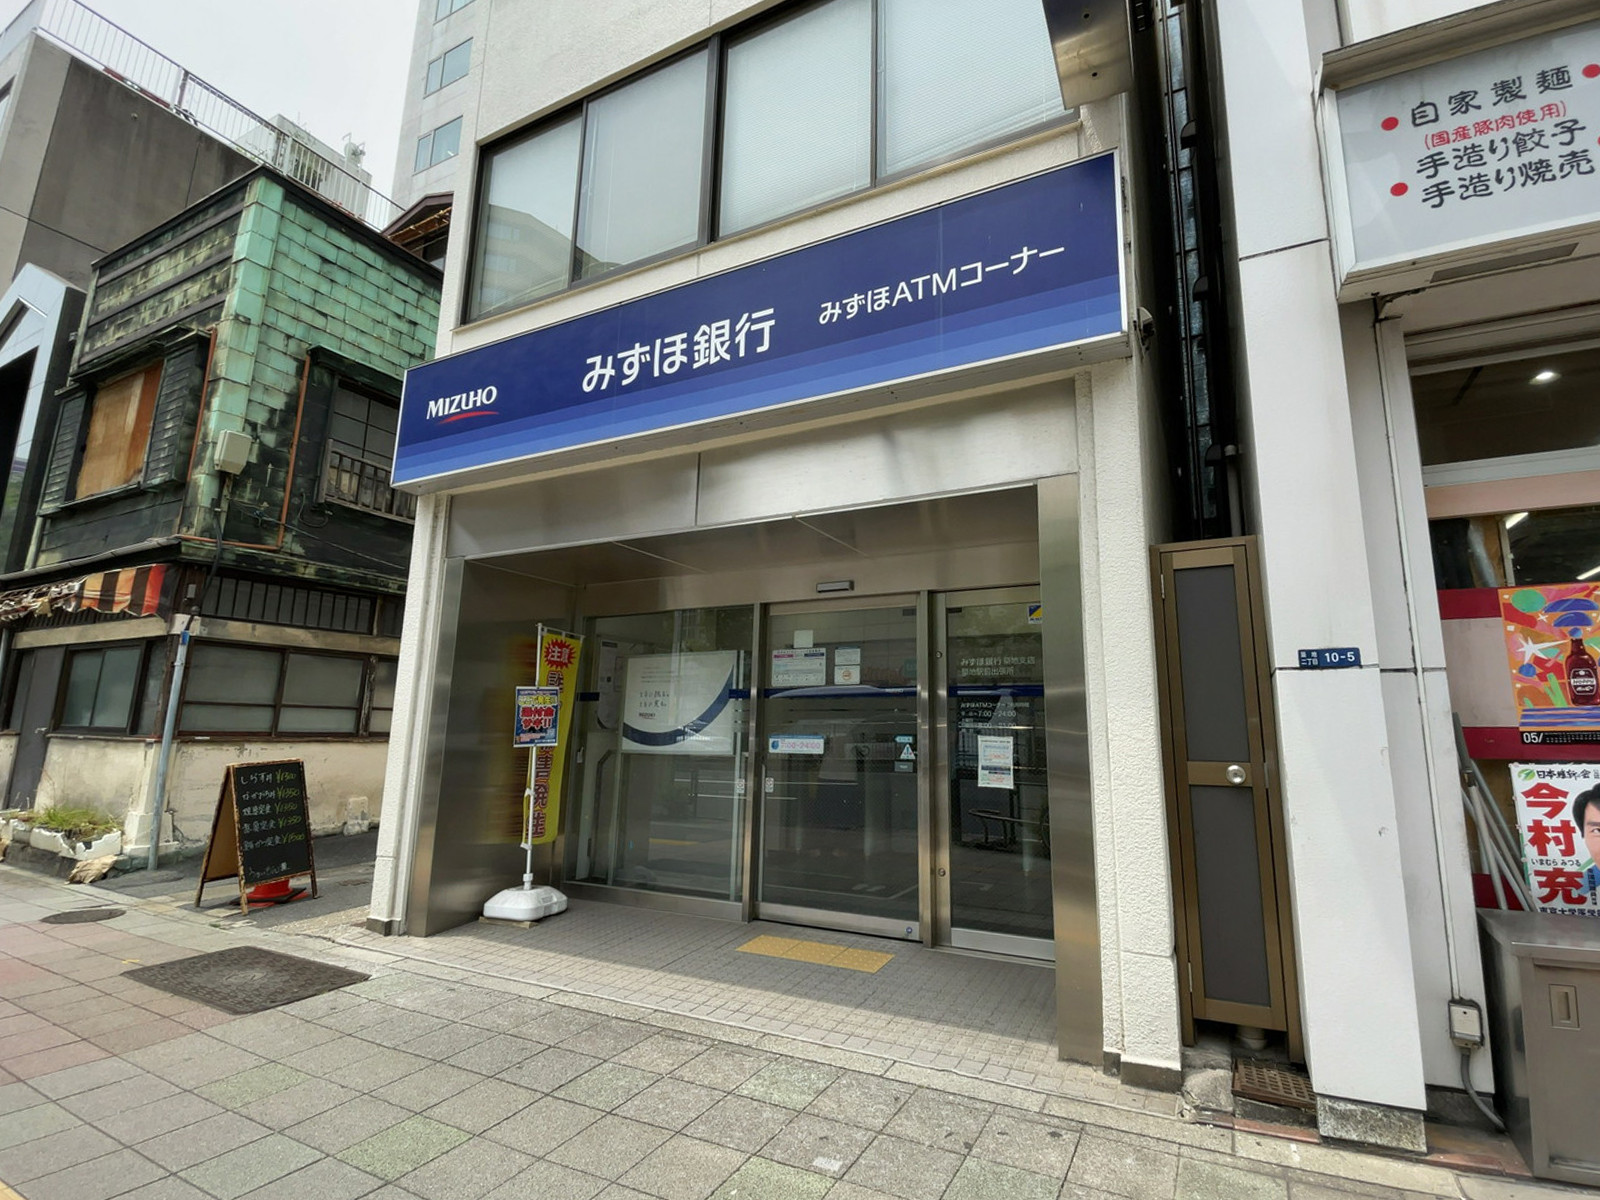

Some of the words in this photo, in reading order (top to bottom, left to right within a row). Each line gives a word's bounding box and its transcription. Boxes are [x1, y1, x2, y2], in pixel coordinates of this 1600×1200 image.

[1411, 65, 1573, 127] 自家製麺
[1424, 100, 1567, 150] (国産豚肉使用)
[1416, 118, 1586, 180] 手造り餃子
[1422, 149, 1595, 209] 手造り焼売
[819, 245, 1065, 325] みずほATMコーナー
[581, 307, 775, 393] みずほ銀行
[426, 385, 497, 420] MIZUHO
[548, 645, 570, 663] 注意
[1325, 651, 1355, 663] 10-5
